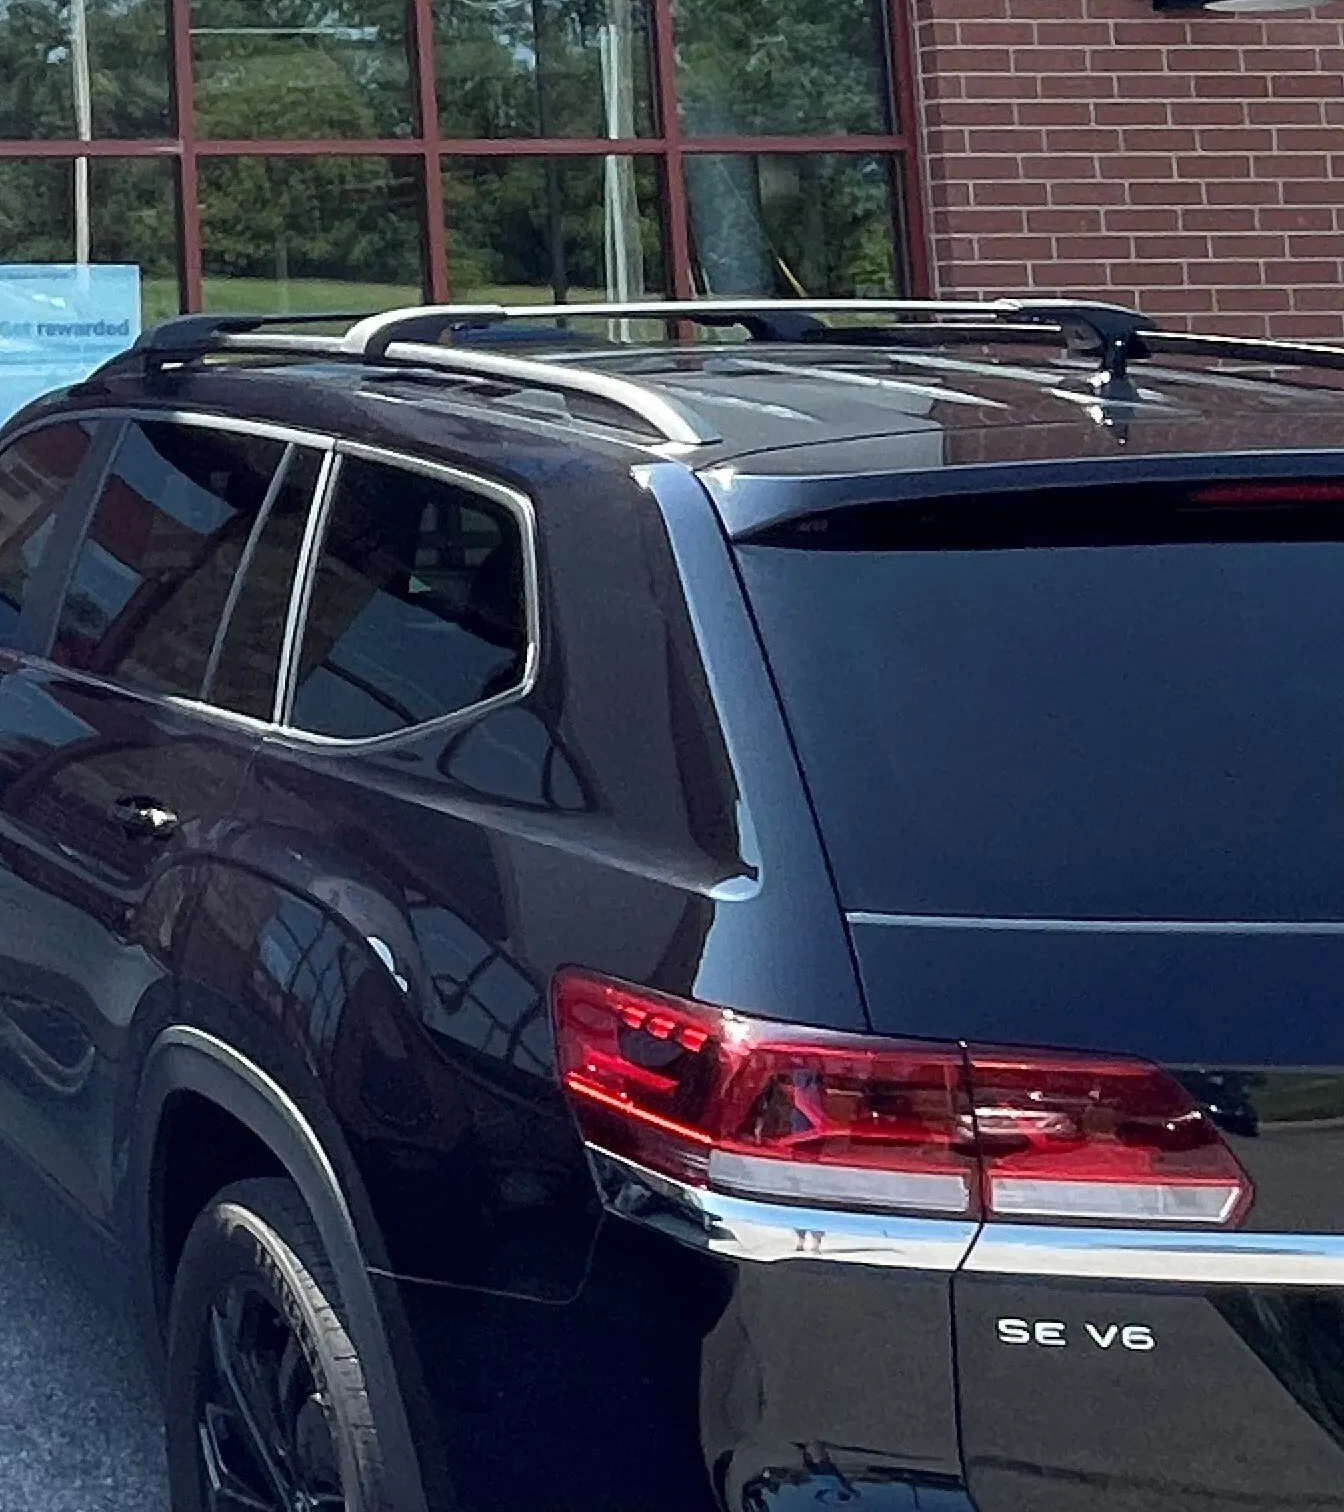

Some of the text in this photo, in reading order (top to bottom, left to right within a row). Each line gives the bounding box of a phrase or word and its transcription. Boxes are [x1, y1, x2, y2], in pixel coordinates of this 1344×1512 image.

[36, 318, 130, 336] rewarded
[997, 1318, 1156, 1351] SE V6
